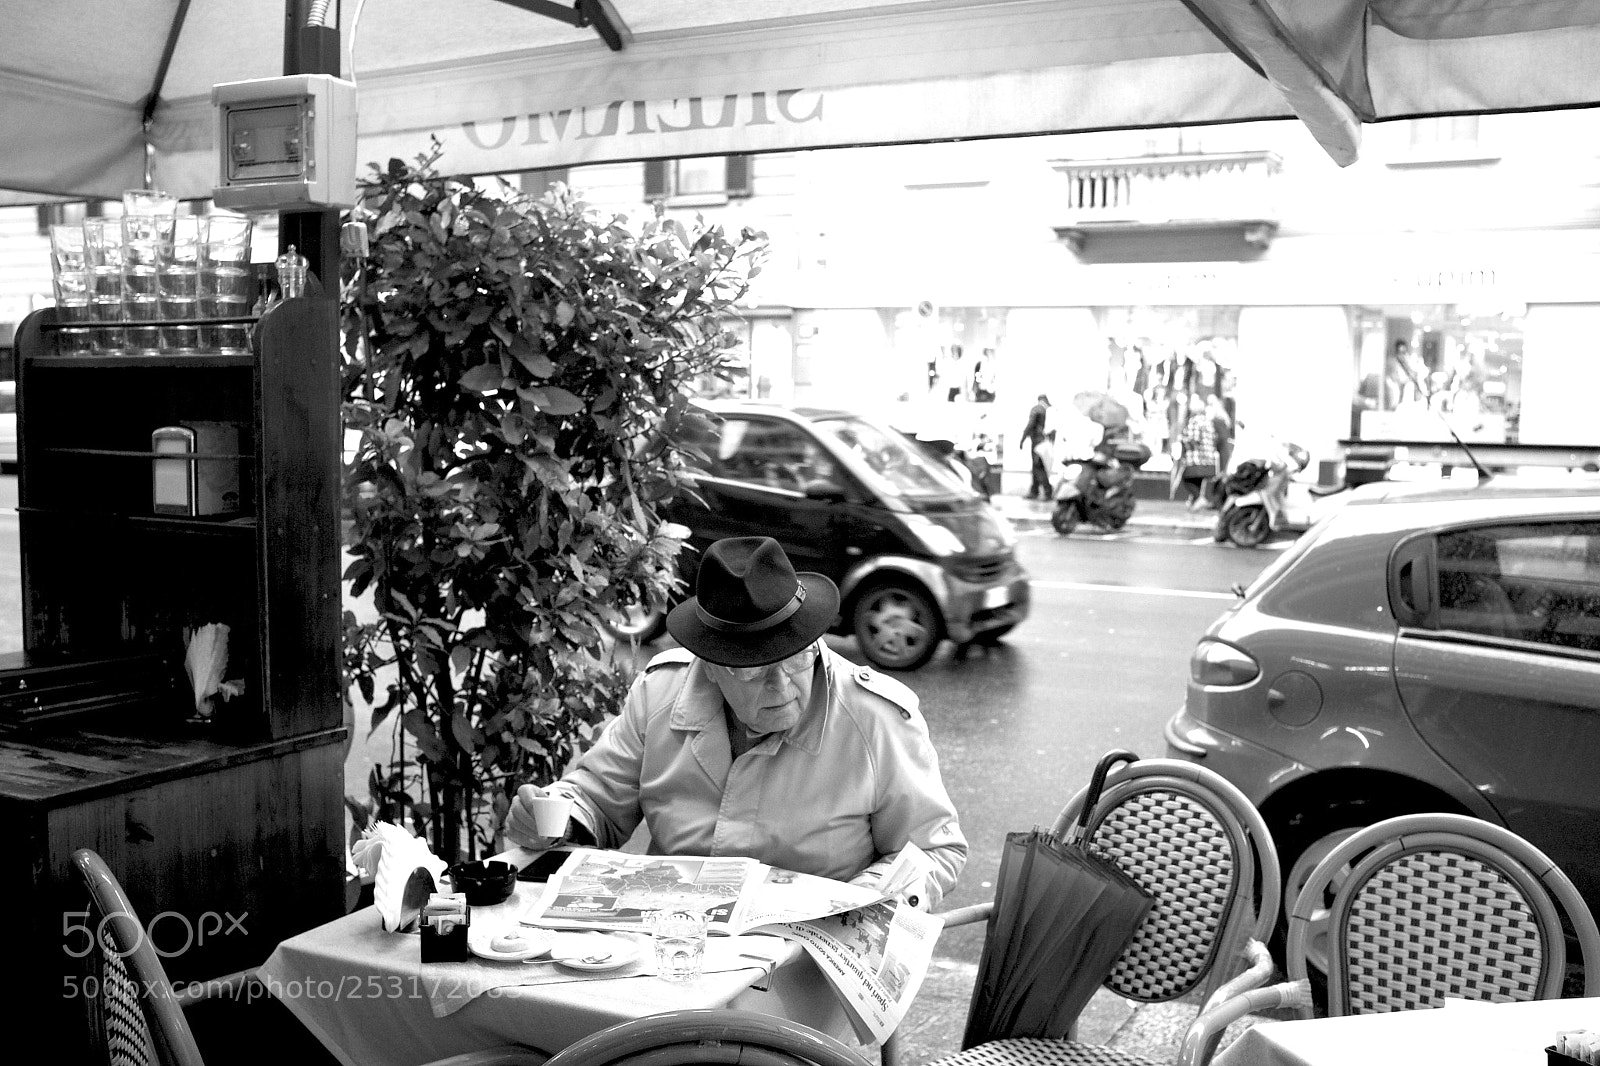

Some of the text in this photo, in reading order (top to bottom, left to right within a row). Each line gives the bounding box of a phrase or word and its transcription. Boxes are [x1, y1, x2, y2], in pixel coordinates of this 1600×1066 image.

[806, 930, 839, 953] generale
[826, 954, 845, 976] AMERICA
[839, 951, 865, 981] quartier
[862, 979, 875, 992] nel
[871, 989, 888, 1012] Spari
